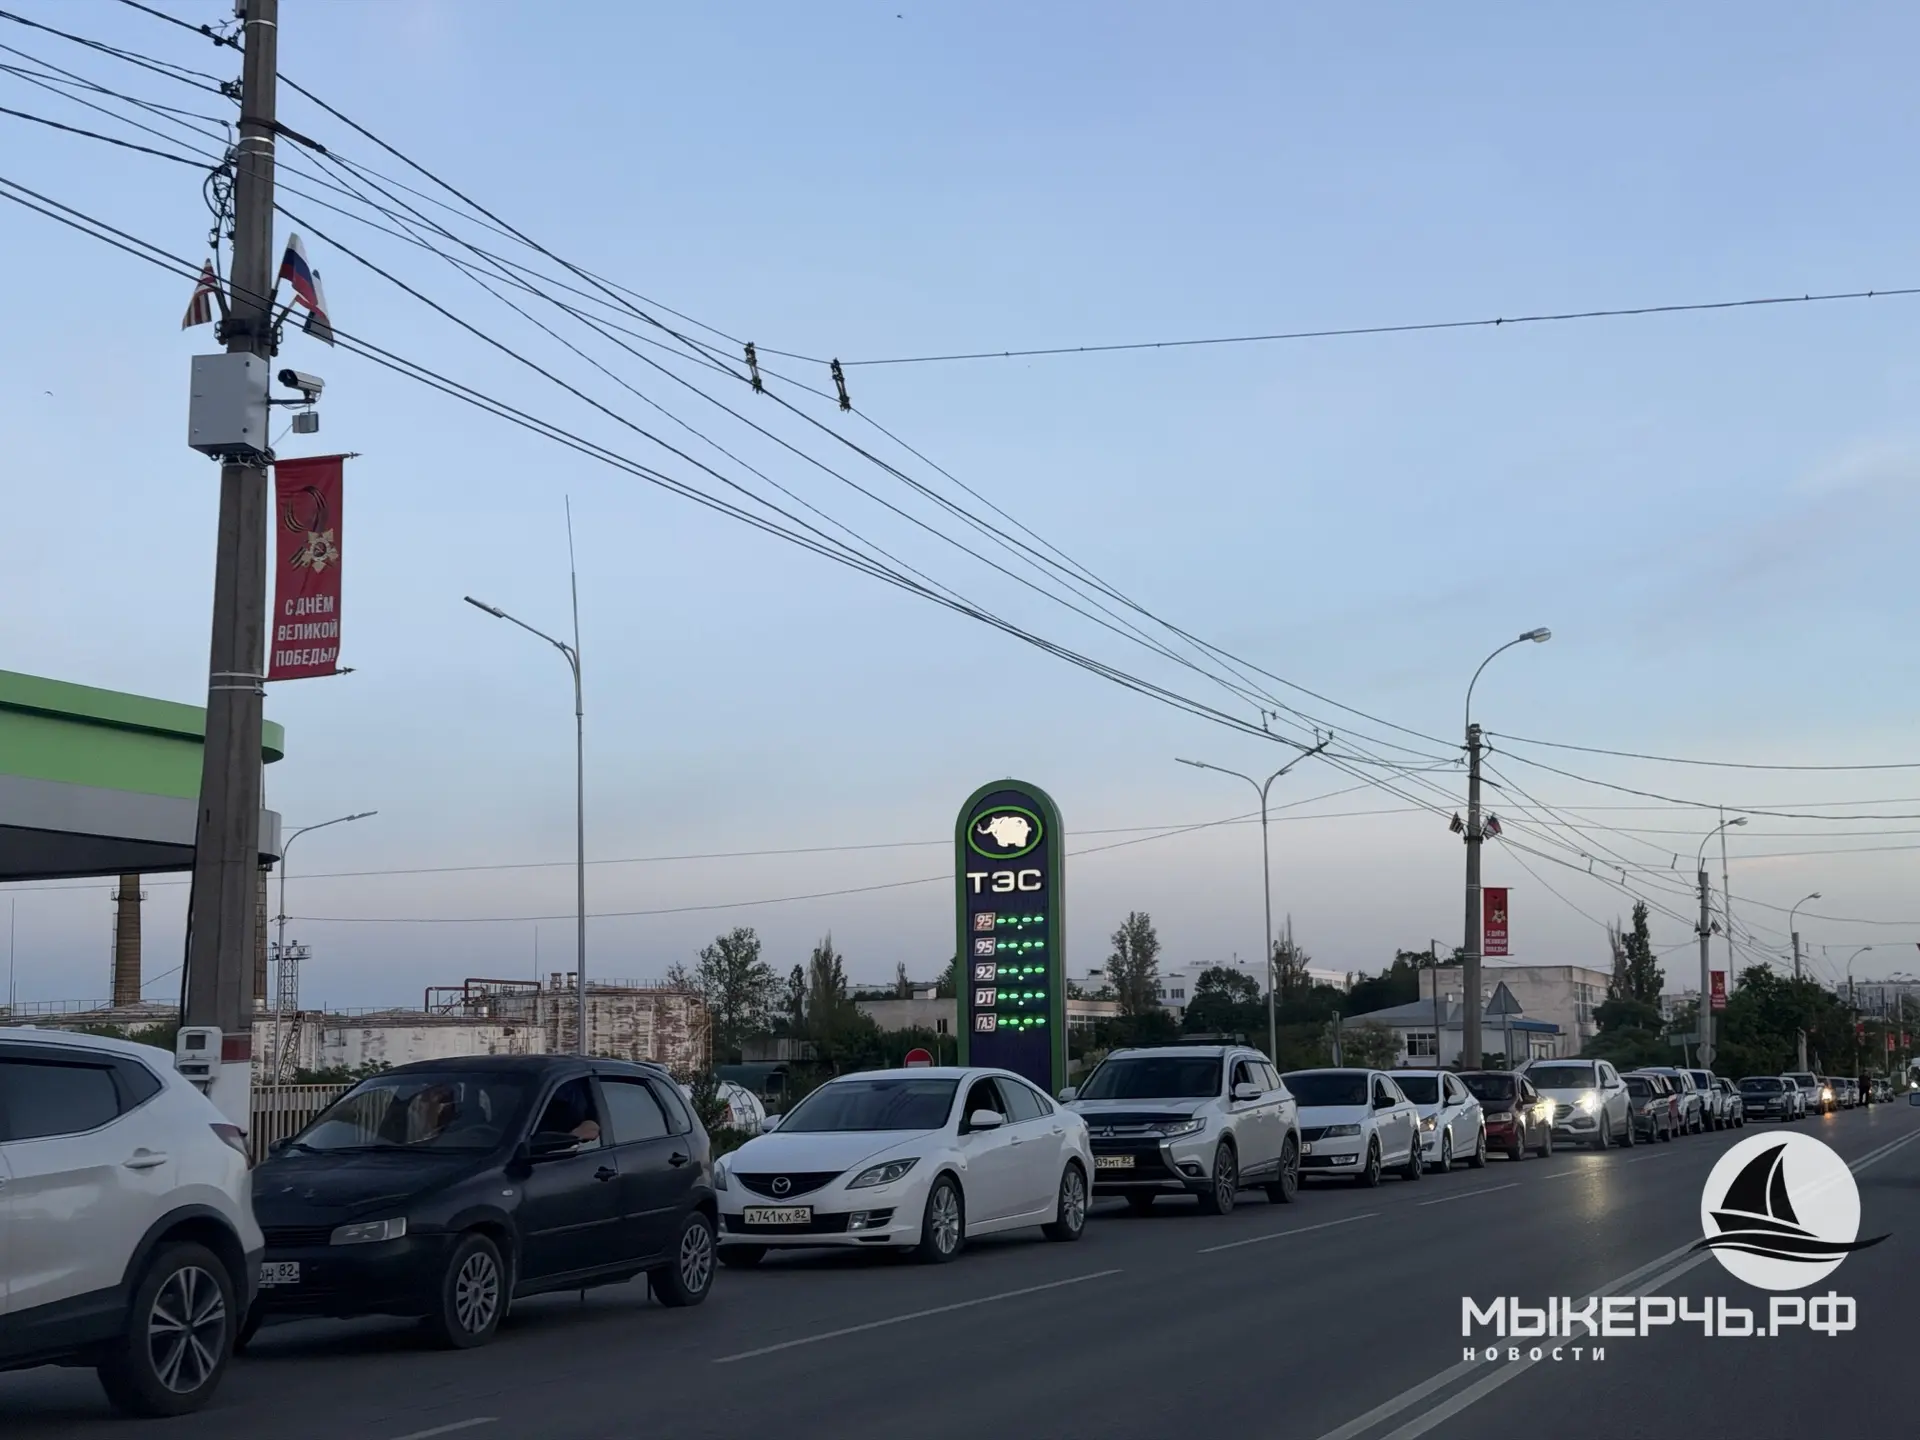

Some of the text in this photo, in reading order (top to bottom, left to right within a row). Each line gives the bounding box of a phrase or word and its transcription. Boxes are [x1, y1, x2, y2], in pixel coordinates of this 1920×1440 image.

[285, 594, 334, 616] С ДНЁМ
[277, 618, 338, 641] ВЕЛИКОЙ
[275, 647, 337, 668] ПОБЕДЫ!
[966, 869, 1042, 894] ТЭС
[976, 914, 993, 927] 95
[976, 941, 993, 954] 95
[976, 965, 994, 979] 92
[976, 1016, 994, 1030] ГАЗ
